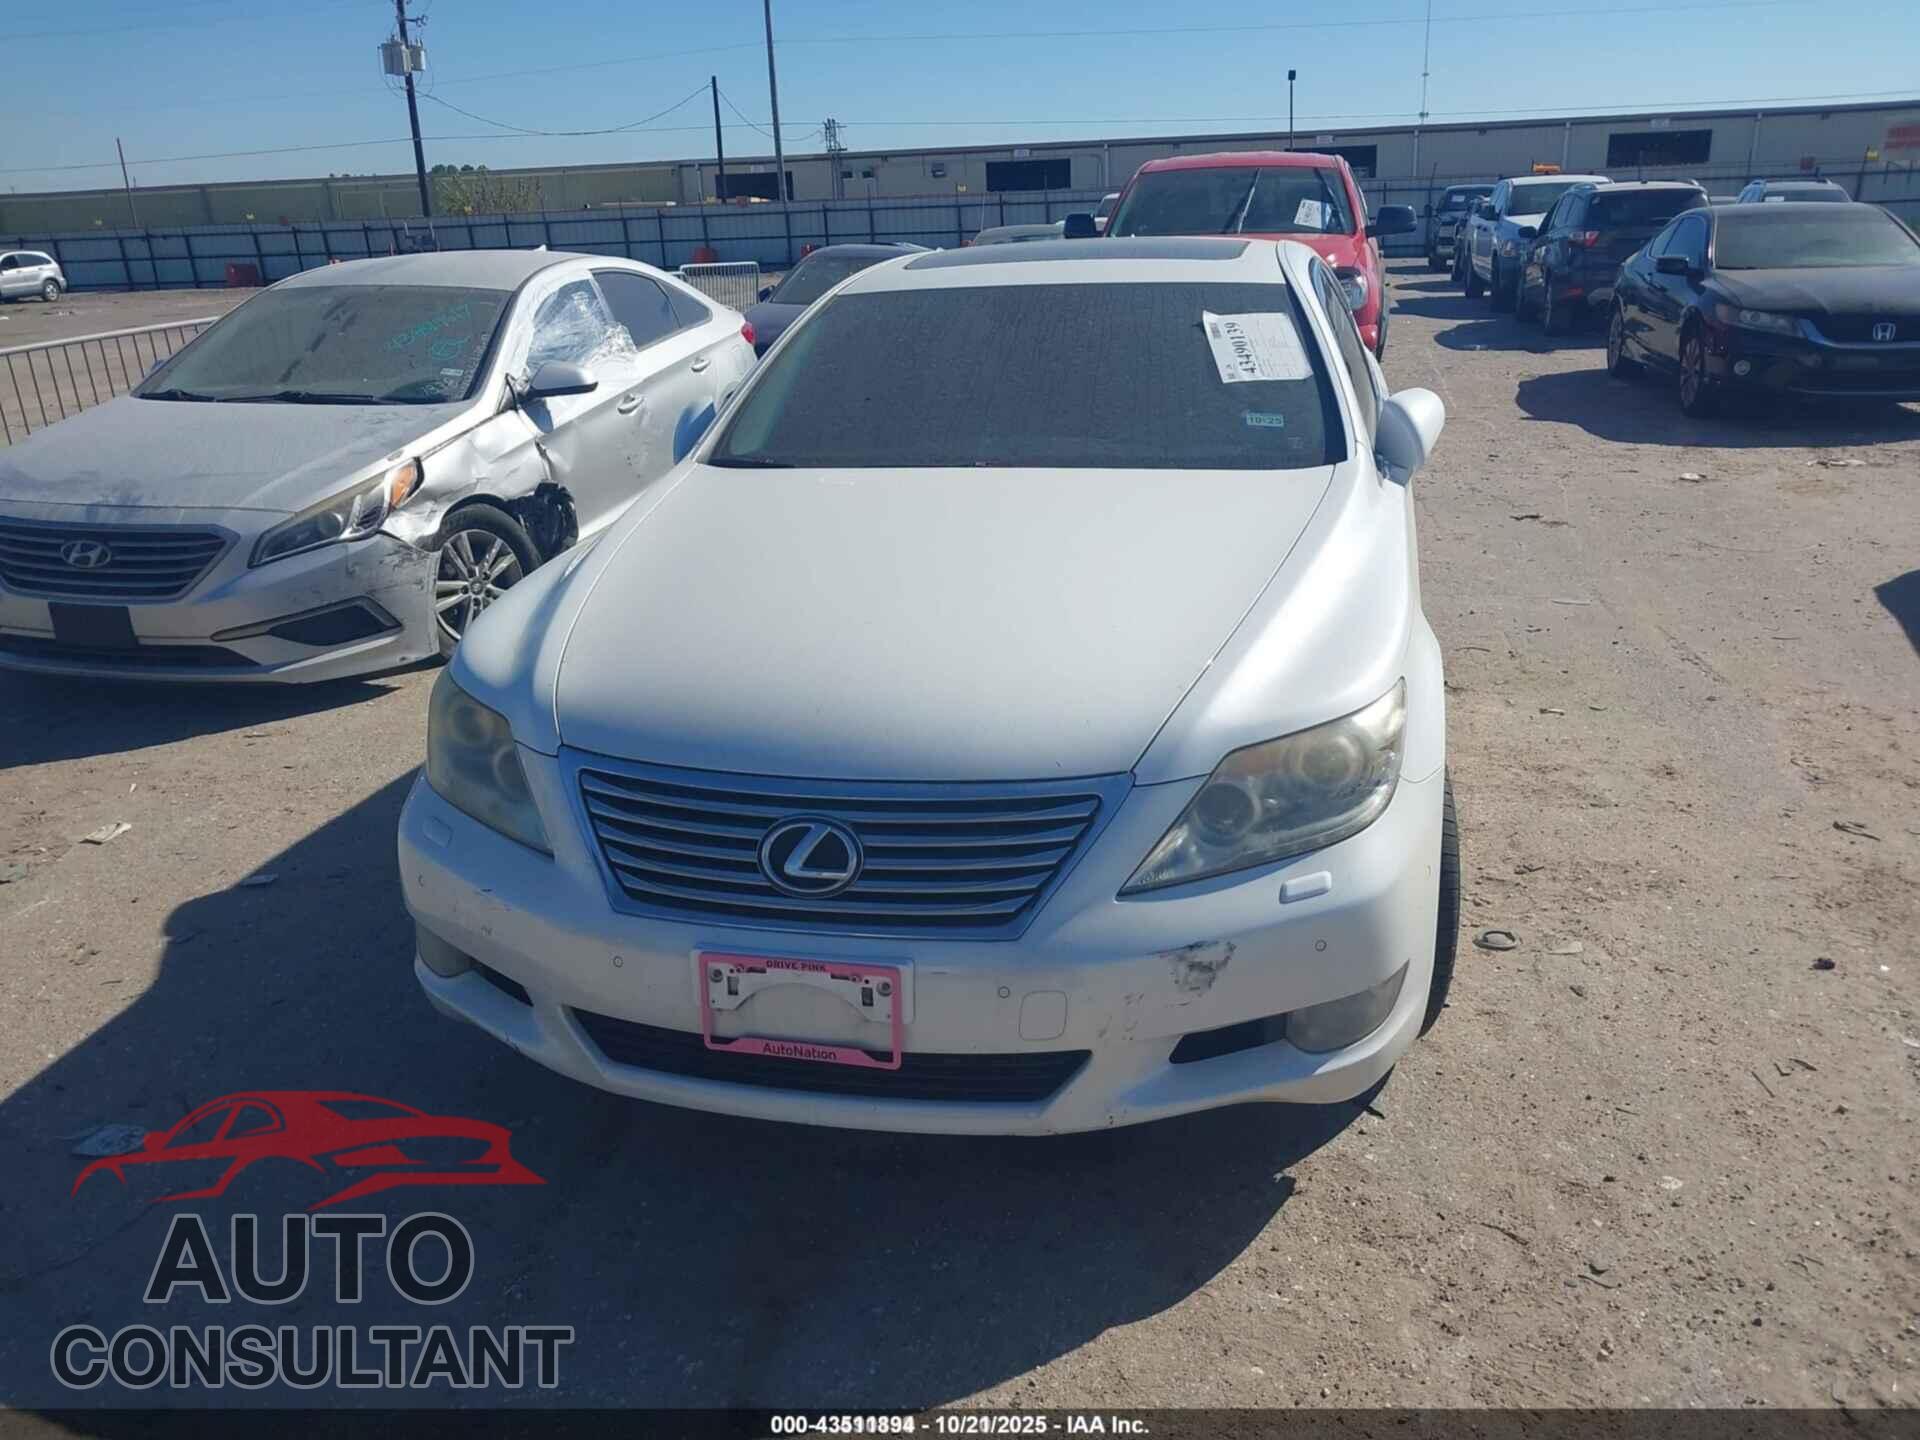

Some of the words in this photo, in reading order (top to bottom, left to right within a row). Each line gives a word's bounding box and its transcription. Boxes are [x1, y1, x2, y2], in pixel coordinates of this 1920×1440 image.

[1223, 321, 1257, 375] 43490139
[766, 959, 799, 971] DRIVE
[801, 961, 827, 973] PINK
[762, 1042, 838, 1061] AutoNation
